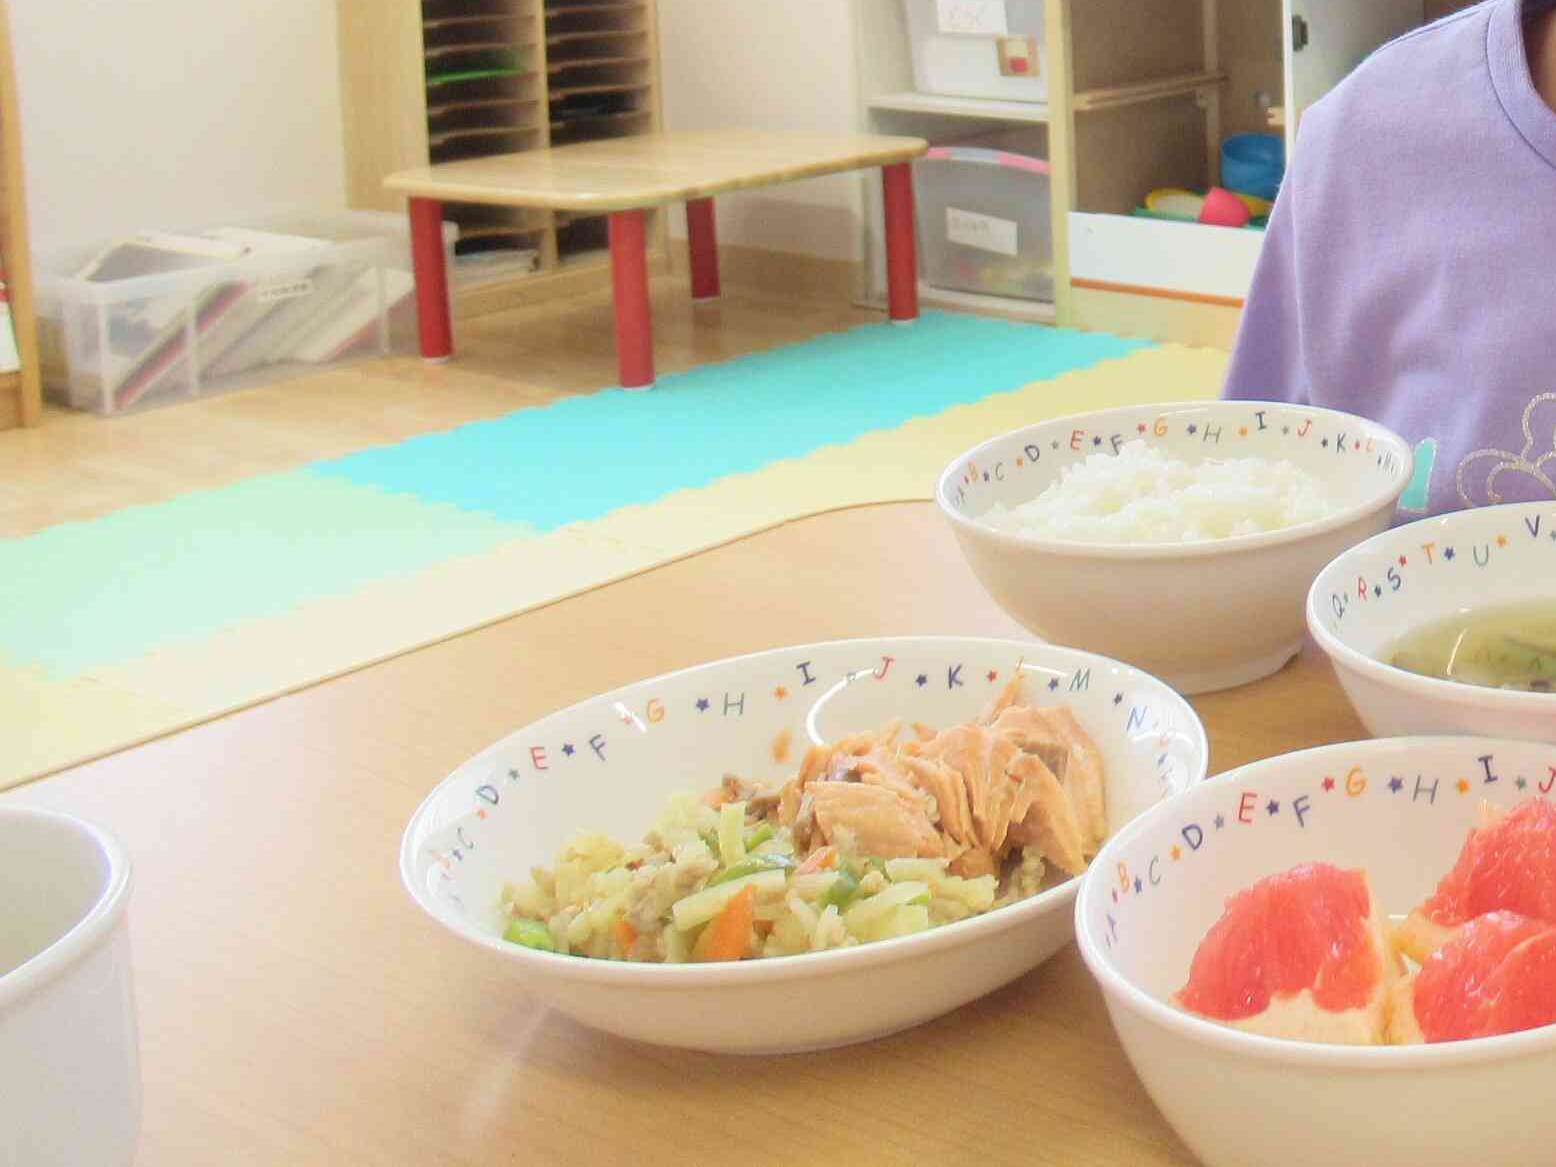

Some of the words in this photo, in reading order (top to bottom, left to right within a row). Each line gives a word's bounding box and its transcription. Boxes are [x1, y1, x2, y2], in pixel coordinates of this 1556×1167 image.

[994, 460, 1006, 482] C
[1024, 443, 1041, 463] D
[1070, 429, 1086, 451] E
[1109, 433, 1123, 456] F
[1202, 422, 1222, 444] H
[1255, 410, 1268, 431] I
[1297, 417, 1313, 437] J
[1335, 432, 1347, 453] K
[1332, 593, 1345, 619] Q
[1357, 575, 1369, 602] R
[1386, 566, 1402, 592] S
[1421, 541, 1436, 565] T
[1472, 543, 1491, 568] U
[1524, 514, 1541, 538] V
[476, 784, 500, 805] D
[530, 746, 549, 771] E
[589, 733, 607, 762] F
[646, 697, 665, 723] G
[723, 692, 745, 716] H
[796, 661, 817, 686] I
[871, 656, 895, 682] J
[947, 663, 963, 689] K
[1068, 667, 1092, 692] M
[1126, 704, 1149, 732] N
[1118, 860, 1130, 894] B
[1148, 853, 1162, 885] C
[1181, 824, 1204, 851] D
[1238, 791, 1258, 823] E
[1292, 794, 1311, 827] F
[1344, 765, 1367, 797] G
[1412, 775, 1440, 805] H
[1477, 754, 1499, 784] I
